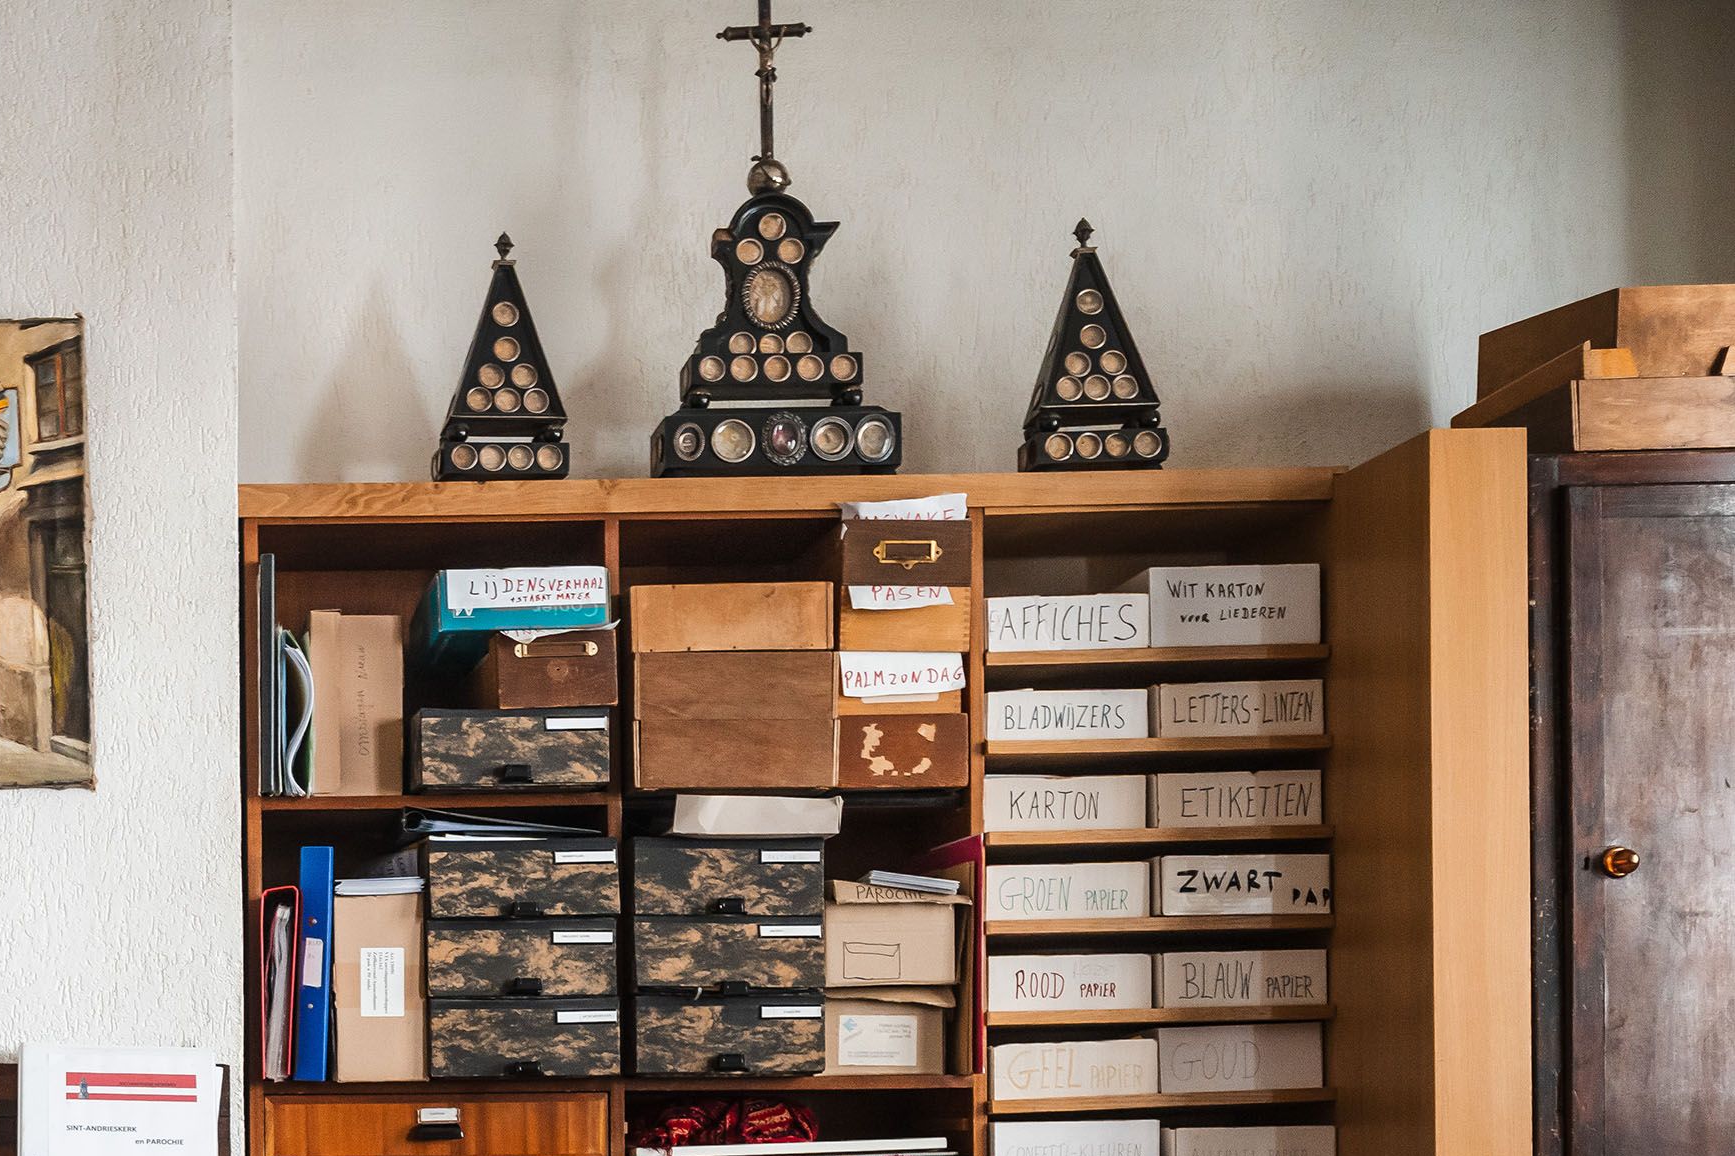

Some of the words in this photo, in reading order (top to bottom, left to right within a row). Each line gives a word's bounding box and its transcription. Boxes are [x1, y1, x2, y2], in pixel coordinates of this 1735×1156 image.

[871, 585, 942, 600] PASEN
[1206, 582, 1265, 598] KARTON
[1000, 602, 1137, 642] AFFICHES
[1220, 606, 1286, 620] LIEDEREN
[1003, 702, 1125, 731] BLADWIJZERS
[1009, 790, 1100, 820] KARTON
[1180, 782, 1312, 819] ETIKETTEN
[998, 875, 1074, 915] GROEN
[1084, 888, 1129, 911] PAPIER
[1176, 868, 1283, 894] ZWART
[1015, 969, 1065, 1000] ROOD
[1079, 982, 1117, 998] PAPIER
[1179, 960, 1254, 1000] BLAUW
[1266, 974, 1313, 999] PAPIER
[1007, 1047, 1082, 1090] GEEL
[1171, 1041, 1261, 1081] GOUD
[146, 1138, 185, 1146] PAROCHIE
